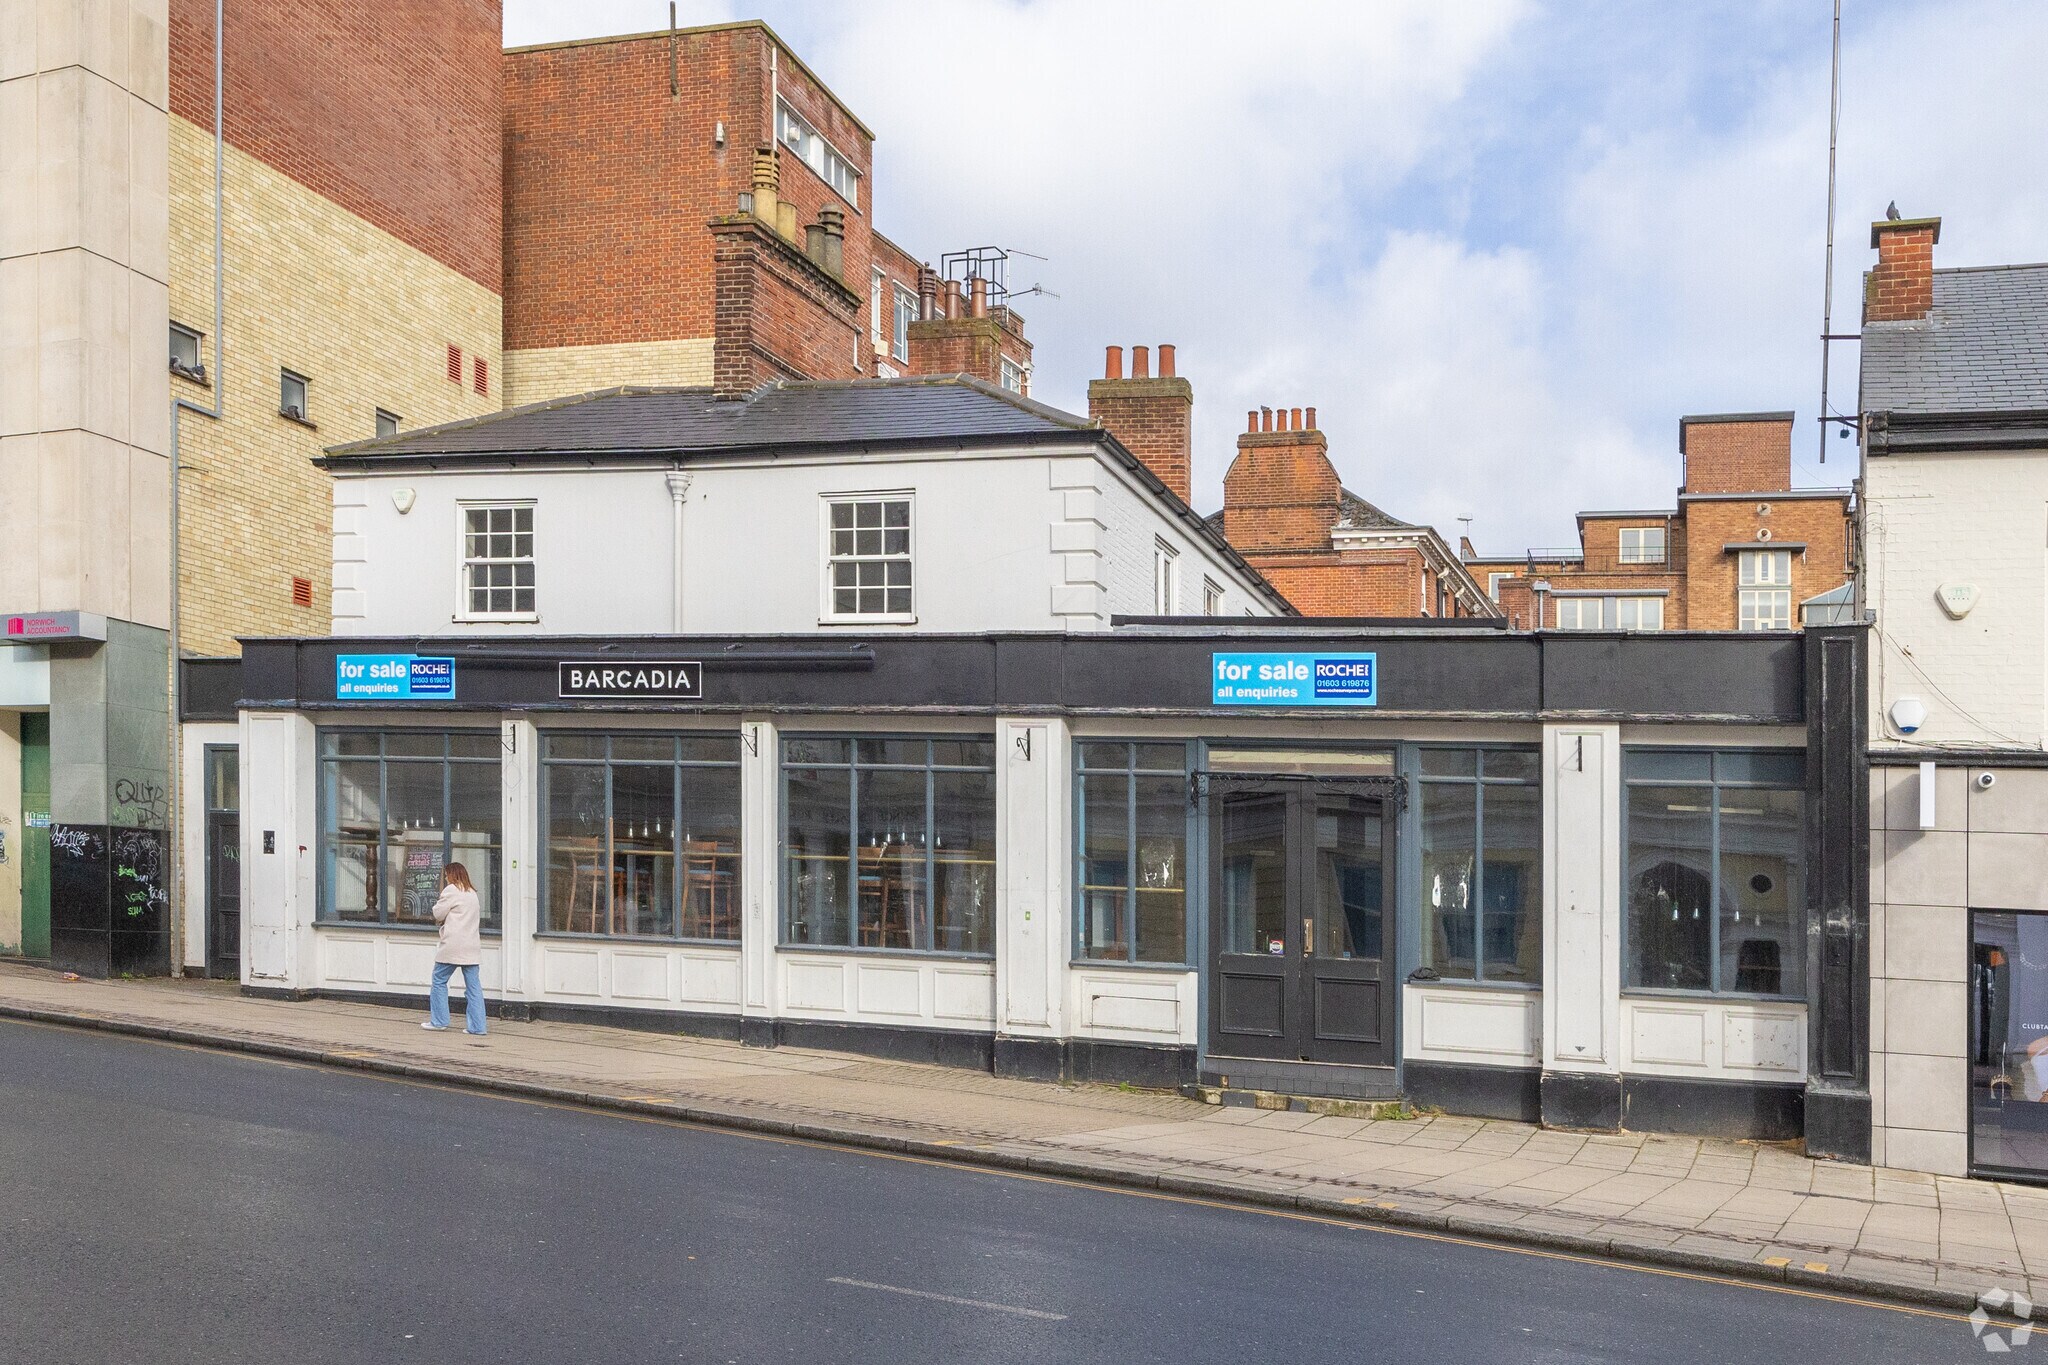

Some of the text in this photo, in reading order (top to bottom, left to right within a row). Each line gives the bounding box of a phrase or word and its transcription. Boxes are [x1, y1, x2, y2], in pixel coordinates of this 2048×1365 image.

[26, 618, 56, 627] NORWICH
[26, 626, 71, 635] ACCOUNTANCY
[340, 661, 407, 678] for sale
[411, 664, 446, 675] ROCHE
[1217, 660, 1310, 680] for sale
[1316, 664, 1365, 677] ROCHE
[571, 669, 691, 689] BARCADIA
[1316, 679, 1370, 687] 01603 619876
[340, 683, 399, 695] all enquiries
[1217, 686, 1298, 699] all enquiries
